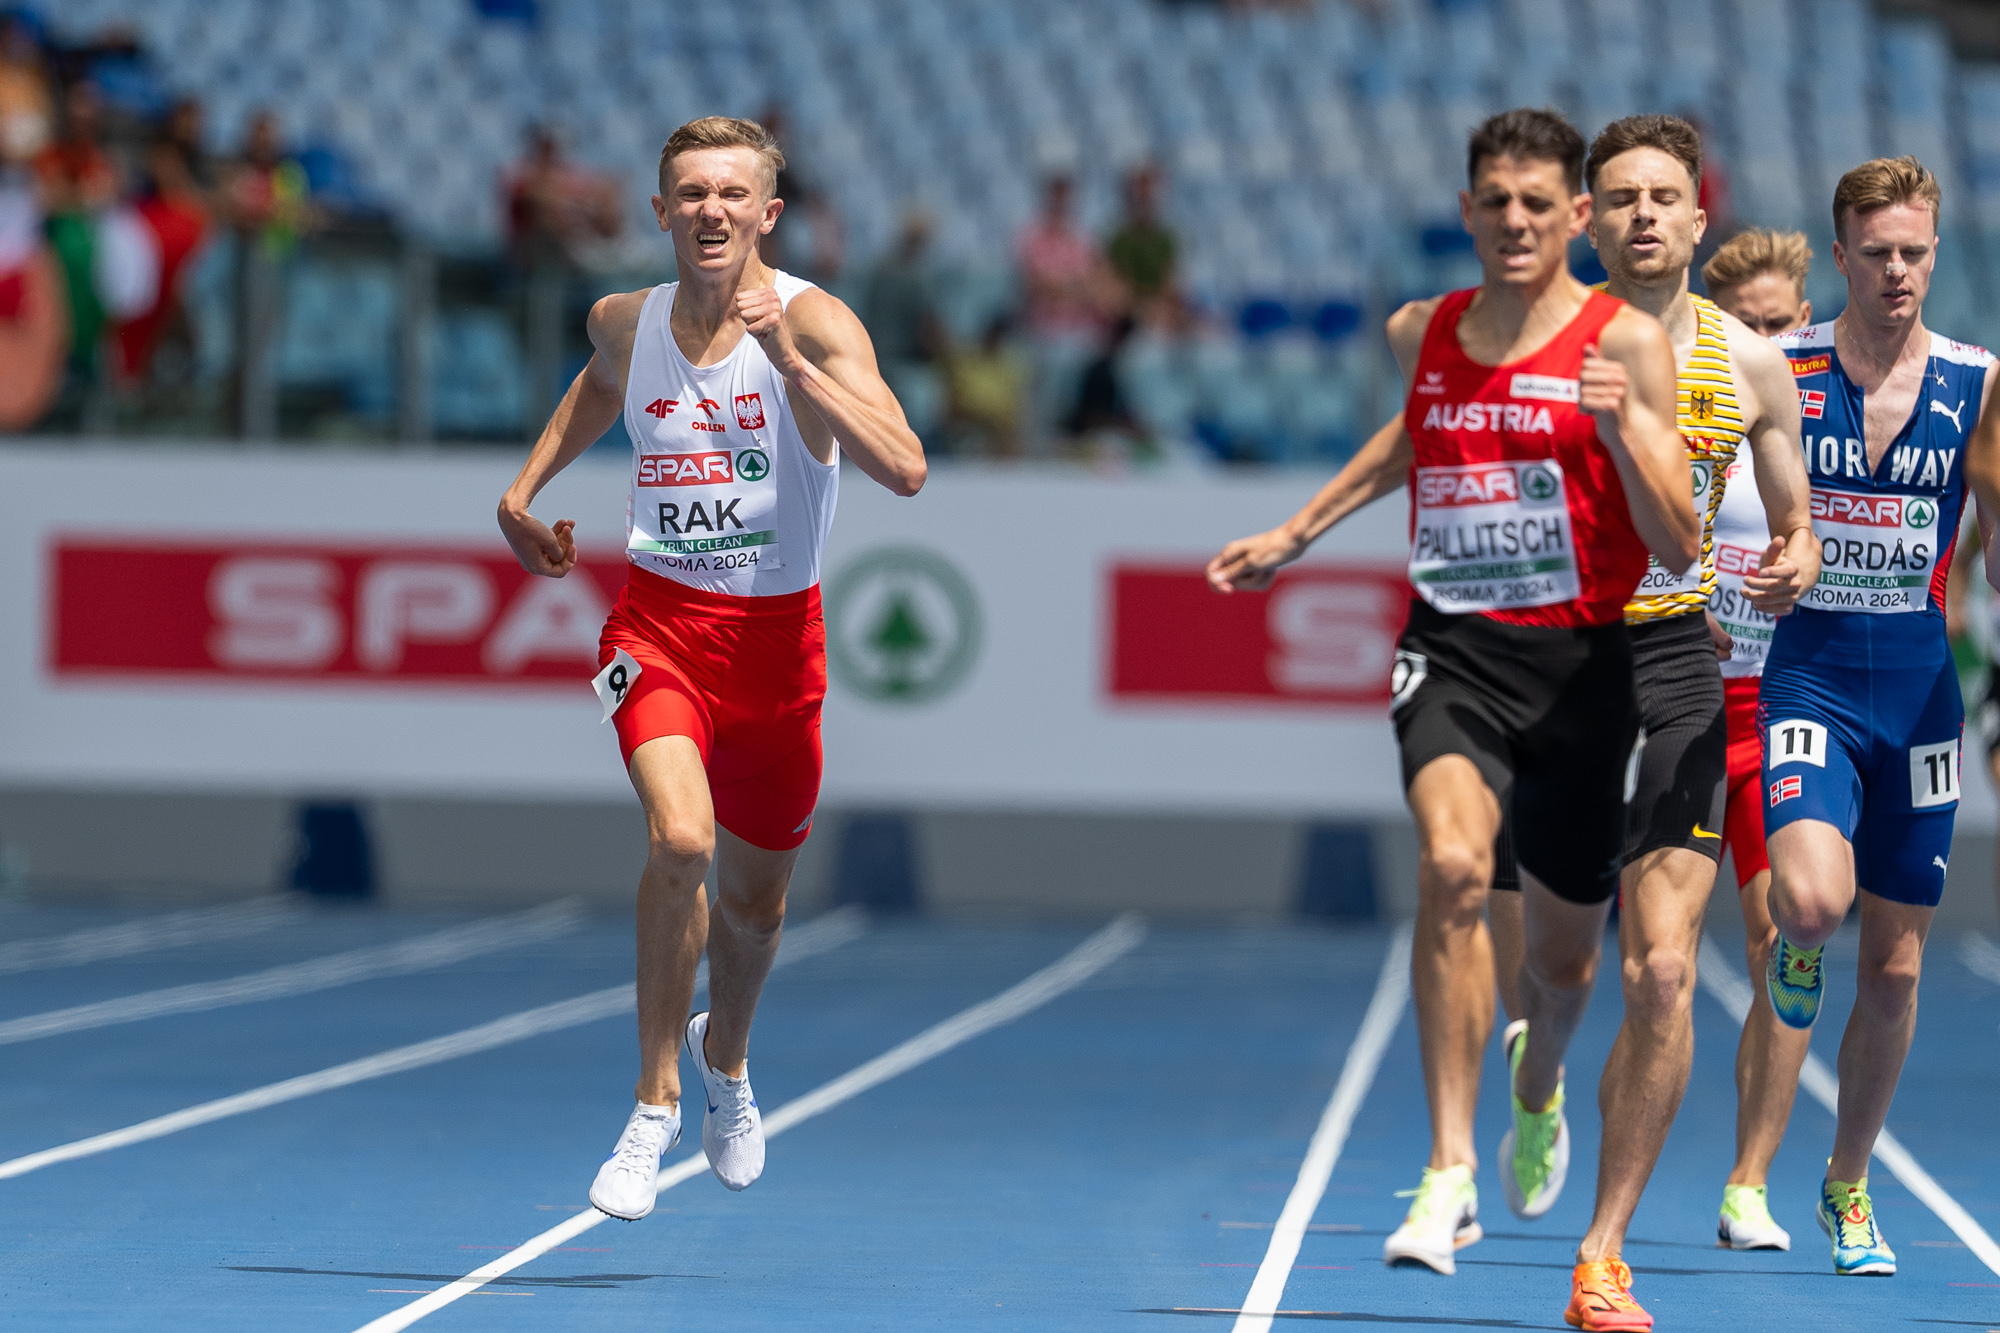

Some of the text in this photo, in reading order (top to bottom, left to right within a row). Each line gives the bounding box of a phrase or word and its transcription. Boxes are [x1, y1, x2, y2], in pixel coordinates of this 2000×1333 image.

[1795, 359, 1828, 373] EXTRA
[645, 398, 679, 419] 4F
[1422, 401, 1556, 436] AUSTRIA
[691, 421, 726, 433] ORLEN
[639, 455, 731, 483] SPAR
[1724, 464, 1742, 479] F
[1420, 469, 1518, 505] SPAR
[658, 497, 745, 535] RAK
[1811, 493, 1900, 525] SPAR
[666, 540, 695, 553] RUN
[1417, 516, 1564, 562] PALLITSCH
[713, 551, 760, 571] 2024
[1816, 536, 1930, 572] ORDÅS
[1501, 579, 1554, 602] 2024
[1641, 571, 1684, 588] 2024
[1826, 573, 1856, 587] RUN
[1810, 588, 1910, 608] ROMA 2024
[1781, 726, 1813, 756] 11
[1924, 750, 1951, 796] 11
